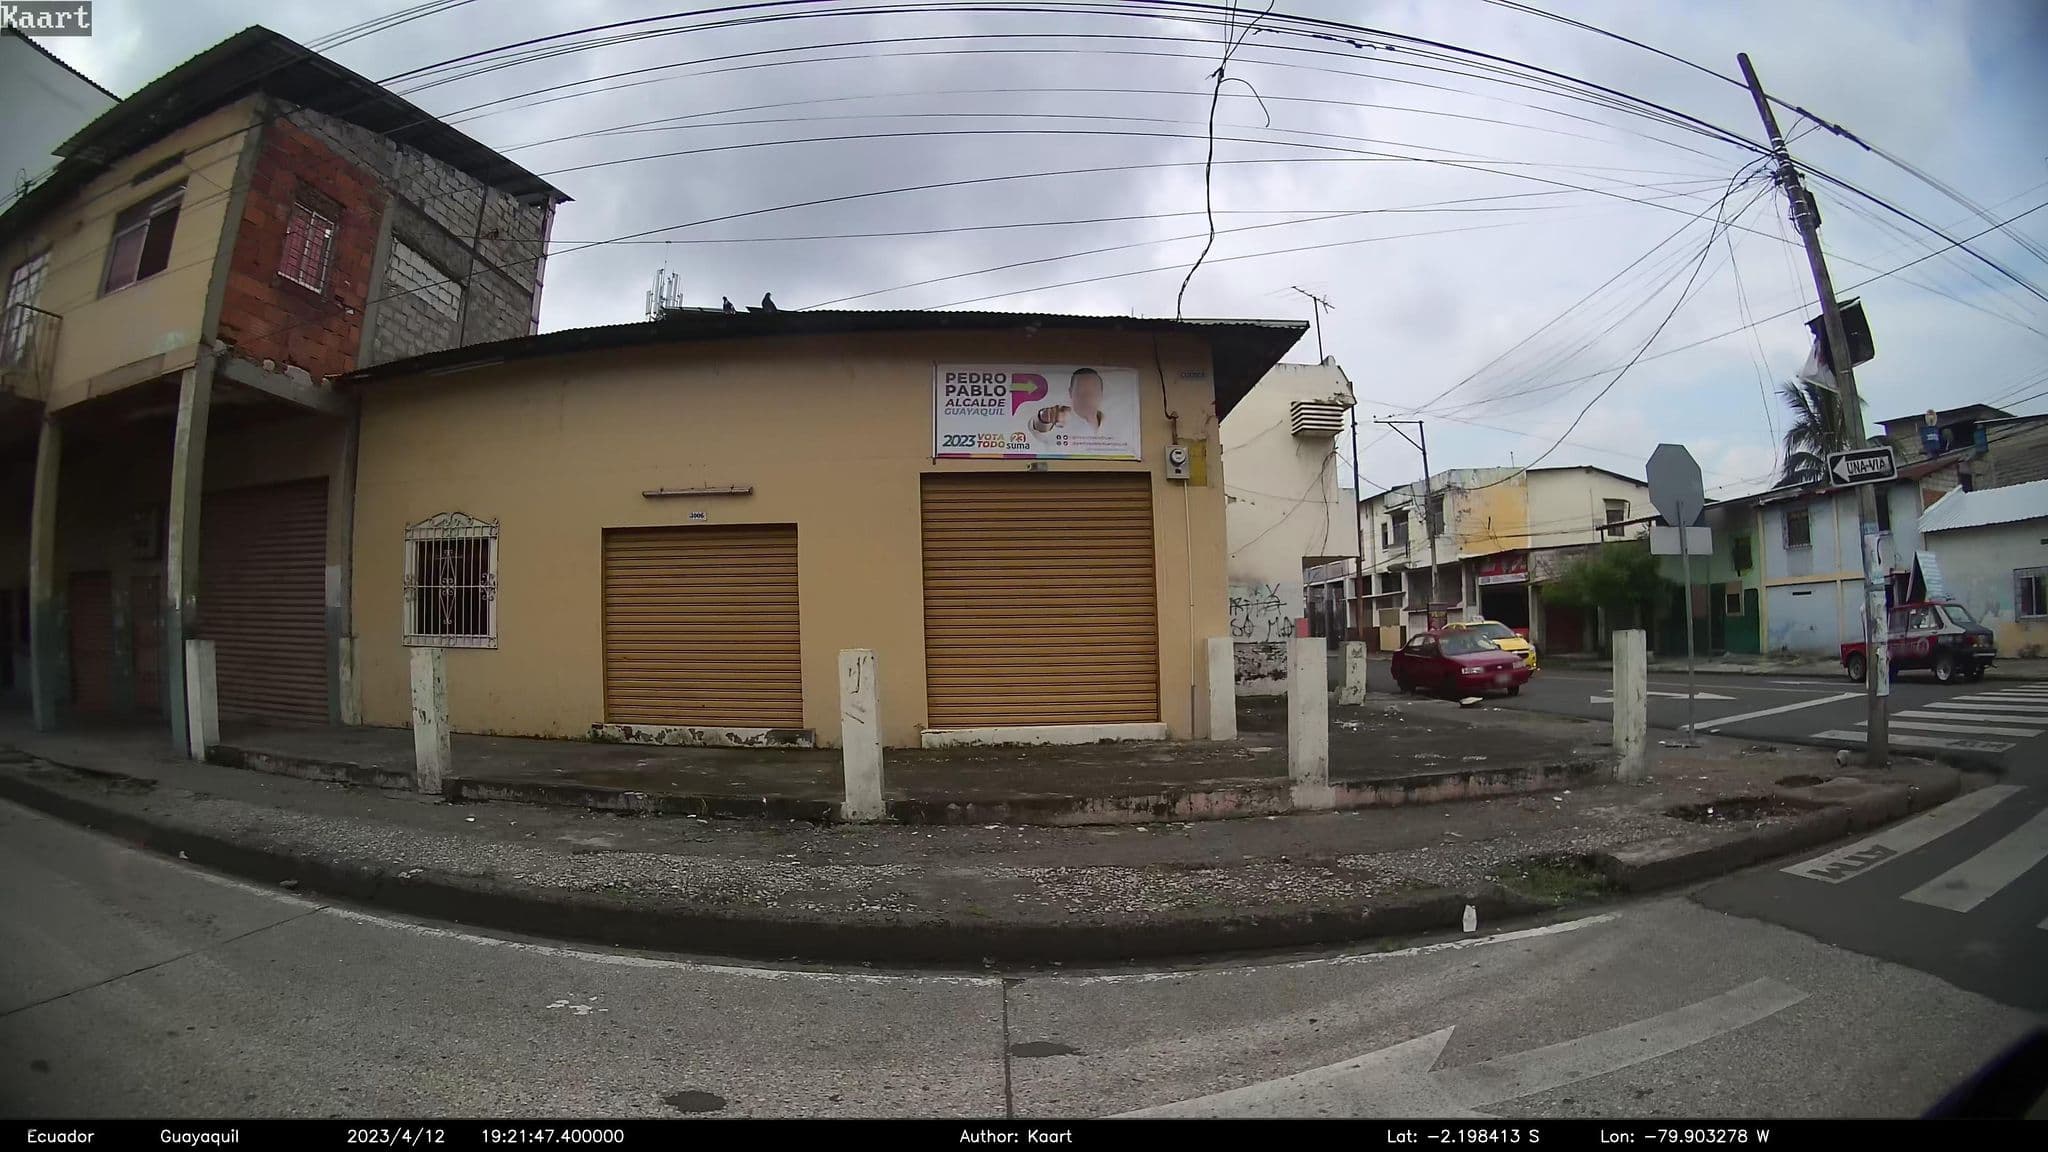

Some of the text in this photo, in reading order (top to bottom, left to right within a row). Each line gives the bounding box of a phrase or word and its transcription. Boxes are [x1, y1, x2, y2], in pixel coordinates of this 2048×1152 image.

[945, 372, 1007, 384] PEDRO
[945, 385, 1007, 396] PABLO
[945, 399, 1006, 408] ALCALDE
[944, 408, 1006, 416] GUAYAQUIL
[942, 435, 976, 447] 2023
[977, 433, 1005, 441] VOTA
[1006, 442, 1030, 450] suma
